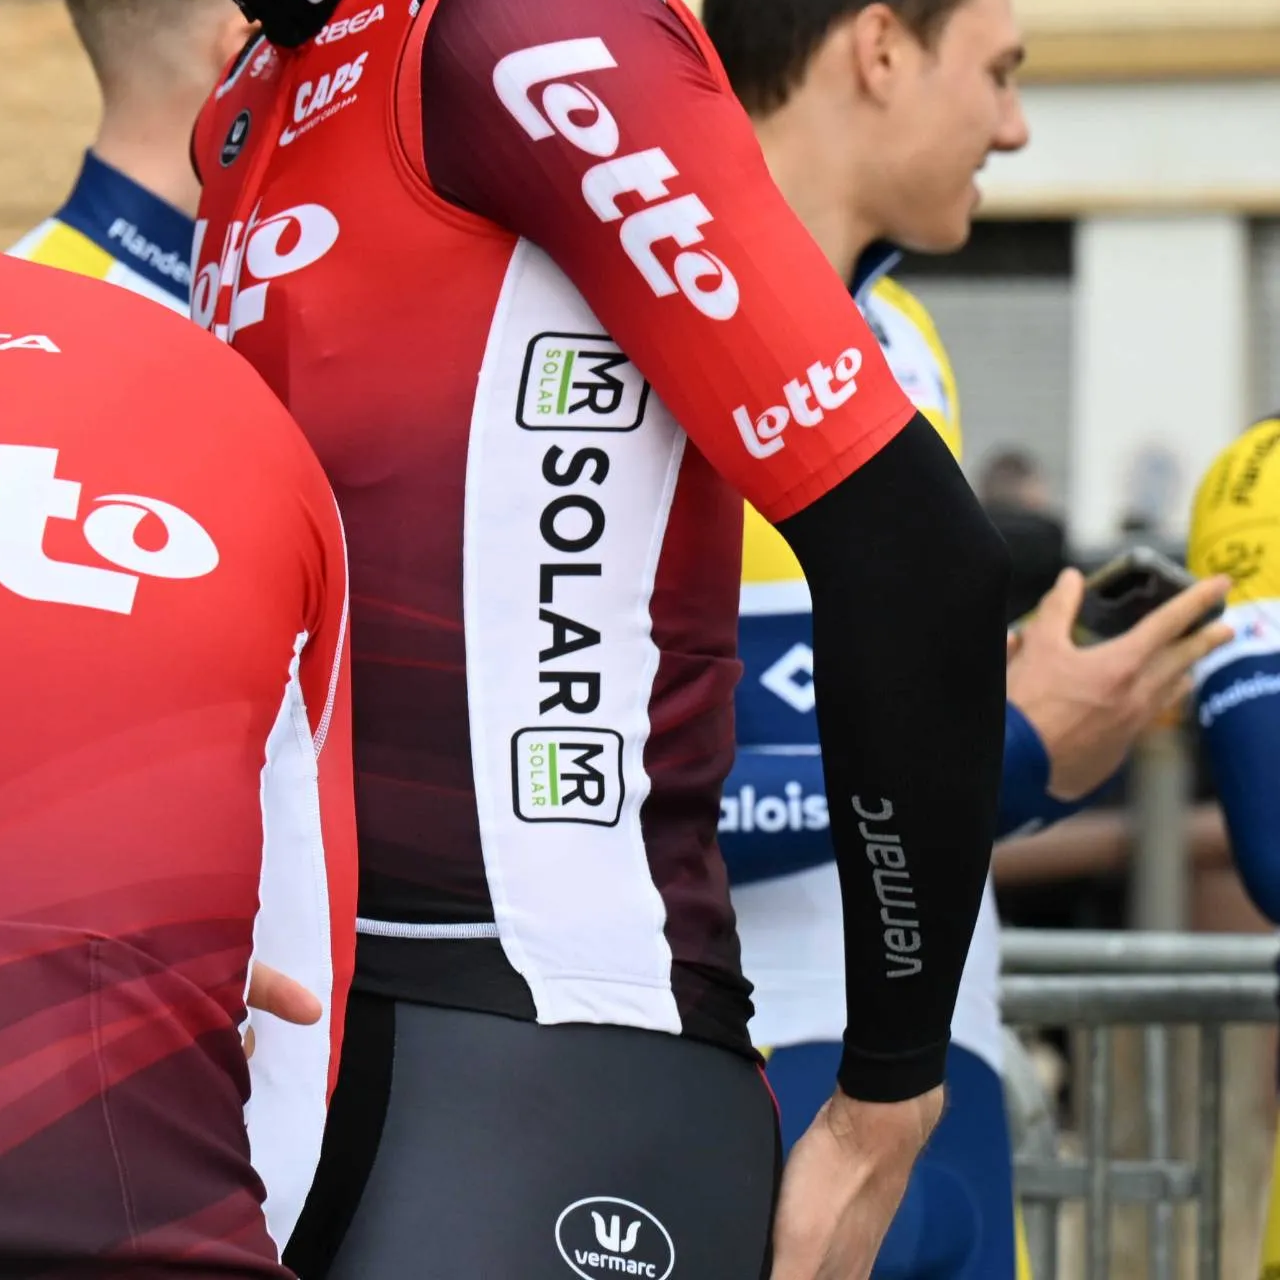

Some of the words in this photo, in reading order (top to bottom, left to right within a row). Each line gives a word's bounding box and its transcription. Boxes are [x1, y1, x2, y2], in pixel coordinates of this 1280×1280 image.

[314, 3, 385, 46] BEA
[293, 51, 369, 123] CAPS
[536, 348, 562, 415] SOLAR
[539, 444, 610, 716] SOLAR
[530, 743, 546, 806] SOLAR
[558, 742, 605, 807] MR
[717, 780, 830, 833] alois
[852, 795, 923, 979] vermarc
[574, 1249, 656, 1278] vermarc
